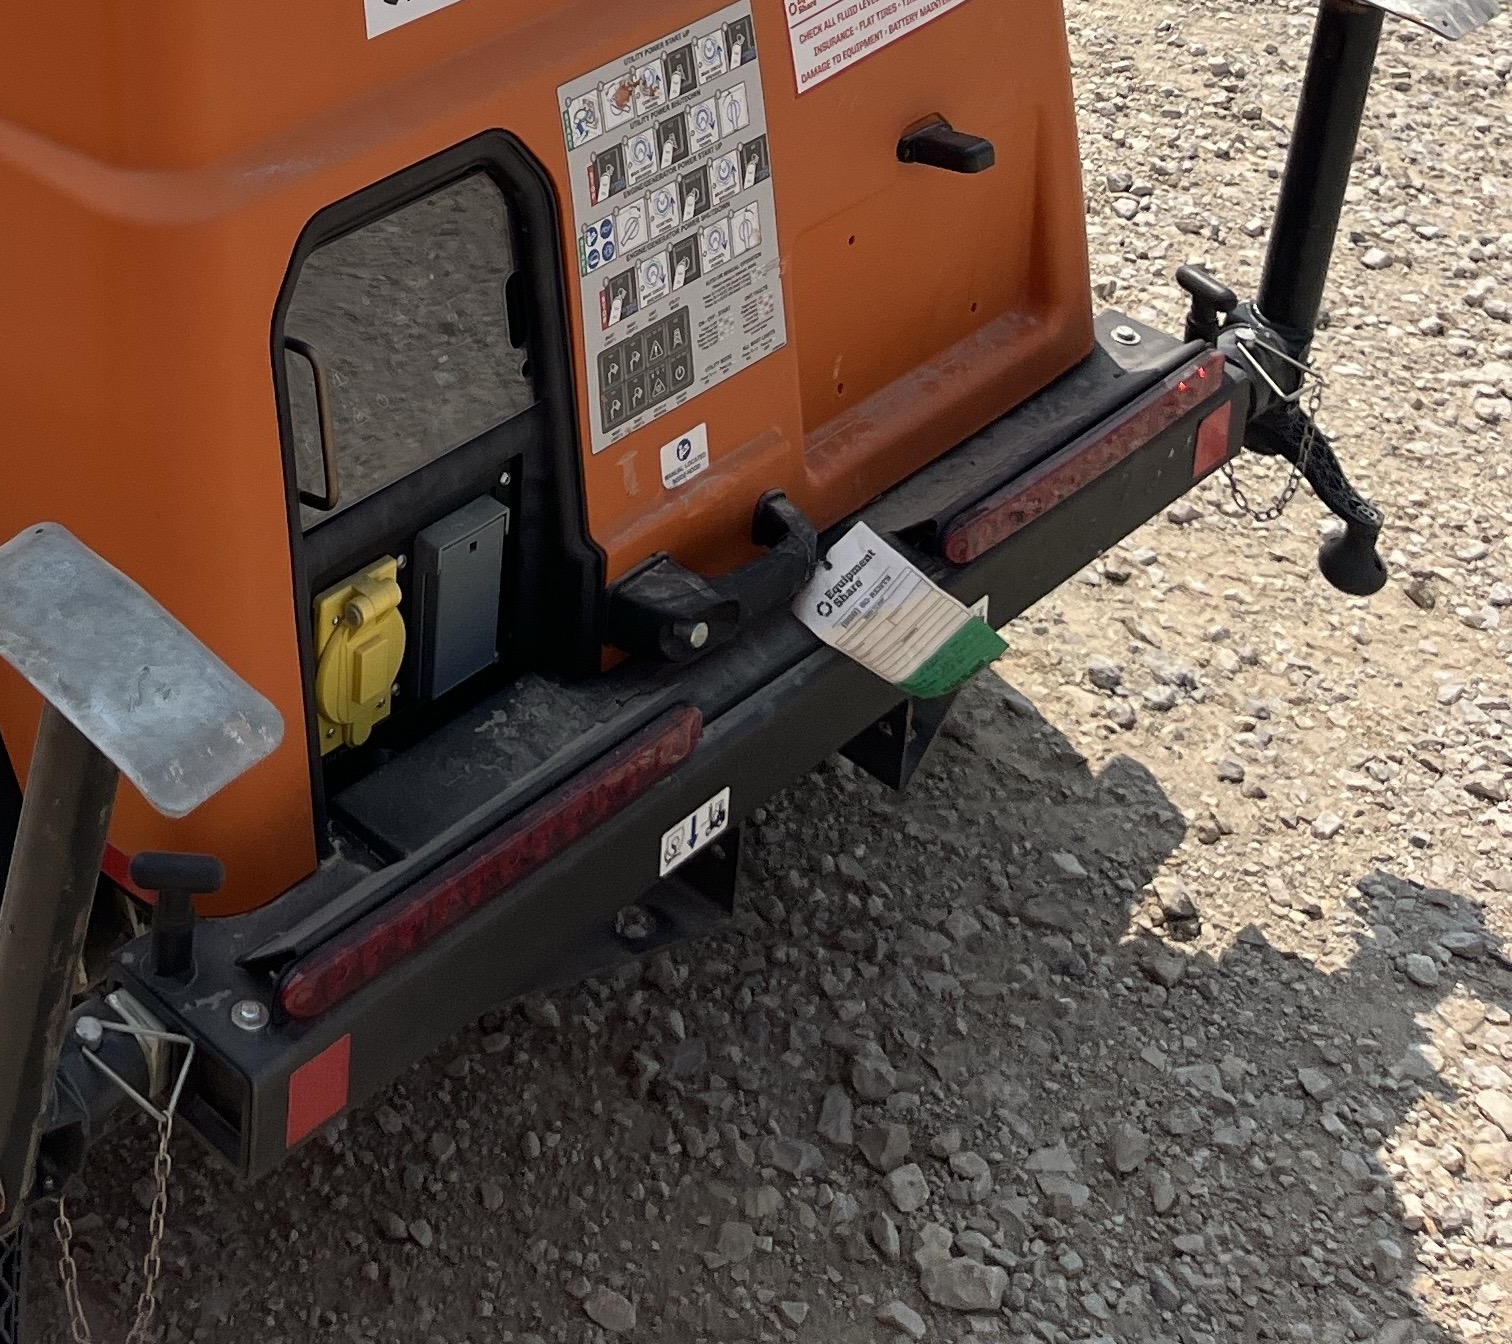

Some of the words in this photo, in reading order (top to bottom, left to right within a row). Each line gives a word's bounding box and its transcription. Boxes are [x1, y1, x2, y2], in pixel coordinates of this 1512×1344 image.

[798, 0, 817, 14] Share
[799, 23, 823, 45] CHECK
[823, 16, 836, 31] ALL
[836, 4, 858, 24] FLUID
[813, 26, 855, 57] INSURANCE
[858, 16, 876, 32] FLAT
[875, 2, 898, 23] TIRES
[801, 59, 831, 85] DAMAGE
[831, 53, 842, 66] TO
[842, 29, 885, 60] EQUIPMENT
[888, 11, 919, 35] BATTERY
[825, 549, 876, 601] Equipment
[833, 578, 864, 609] Share
